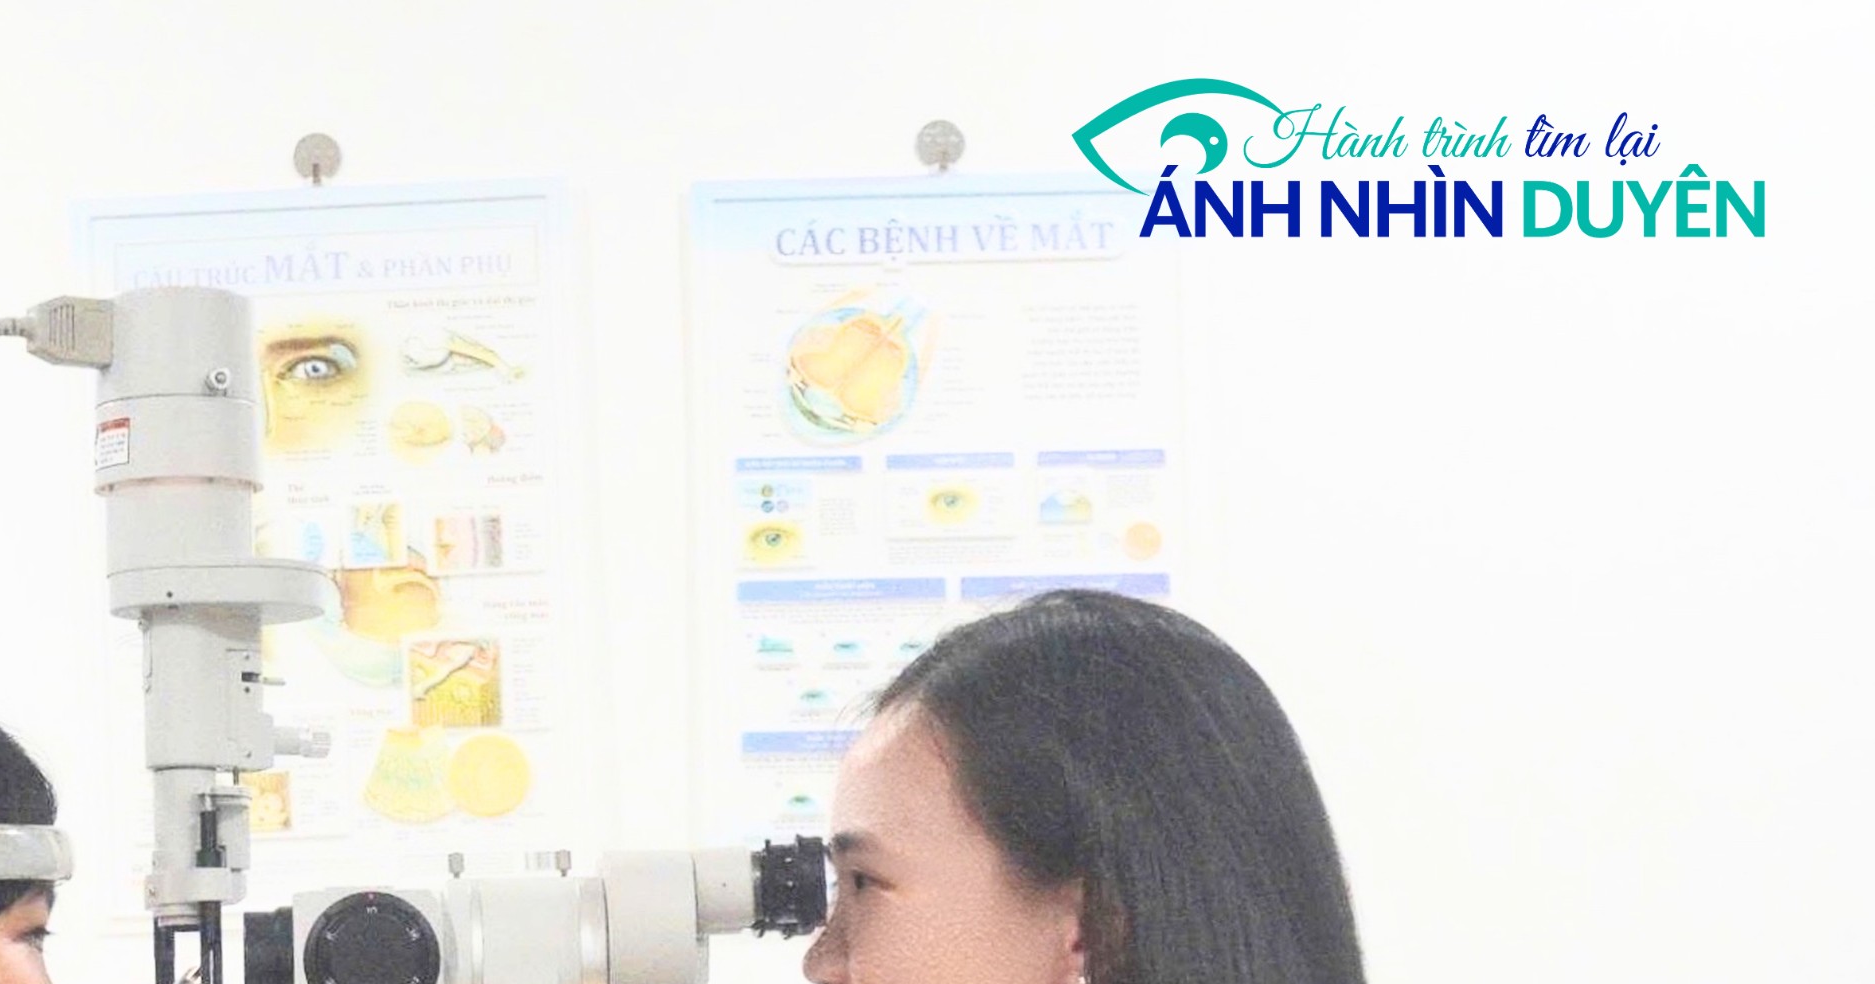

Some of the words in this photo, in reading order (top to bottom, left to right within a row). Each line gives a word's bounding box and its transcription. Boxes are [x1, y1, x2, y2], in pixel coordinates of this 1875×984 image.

[775, 219, 846, 257] CÁC
[858, 217, 959, 261] BỆNH
[973, 214, 1018, 253] VỀ
[1031, 209, 1115, 251] MẮT
[264, 241, 351, 284] MẮT
[357, 258, 374, 279] &
